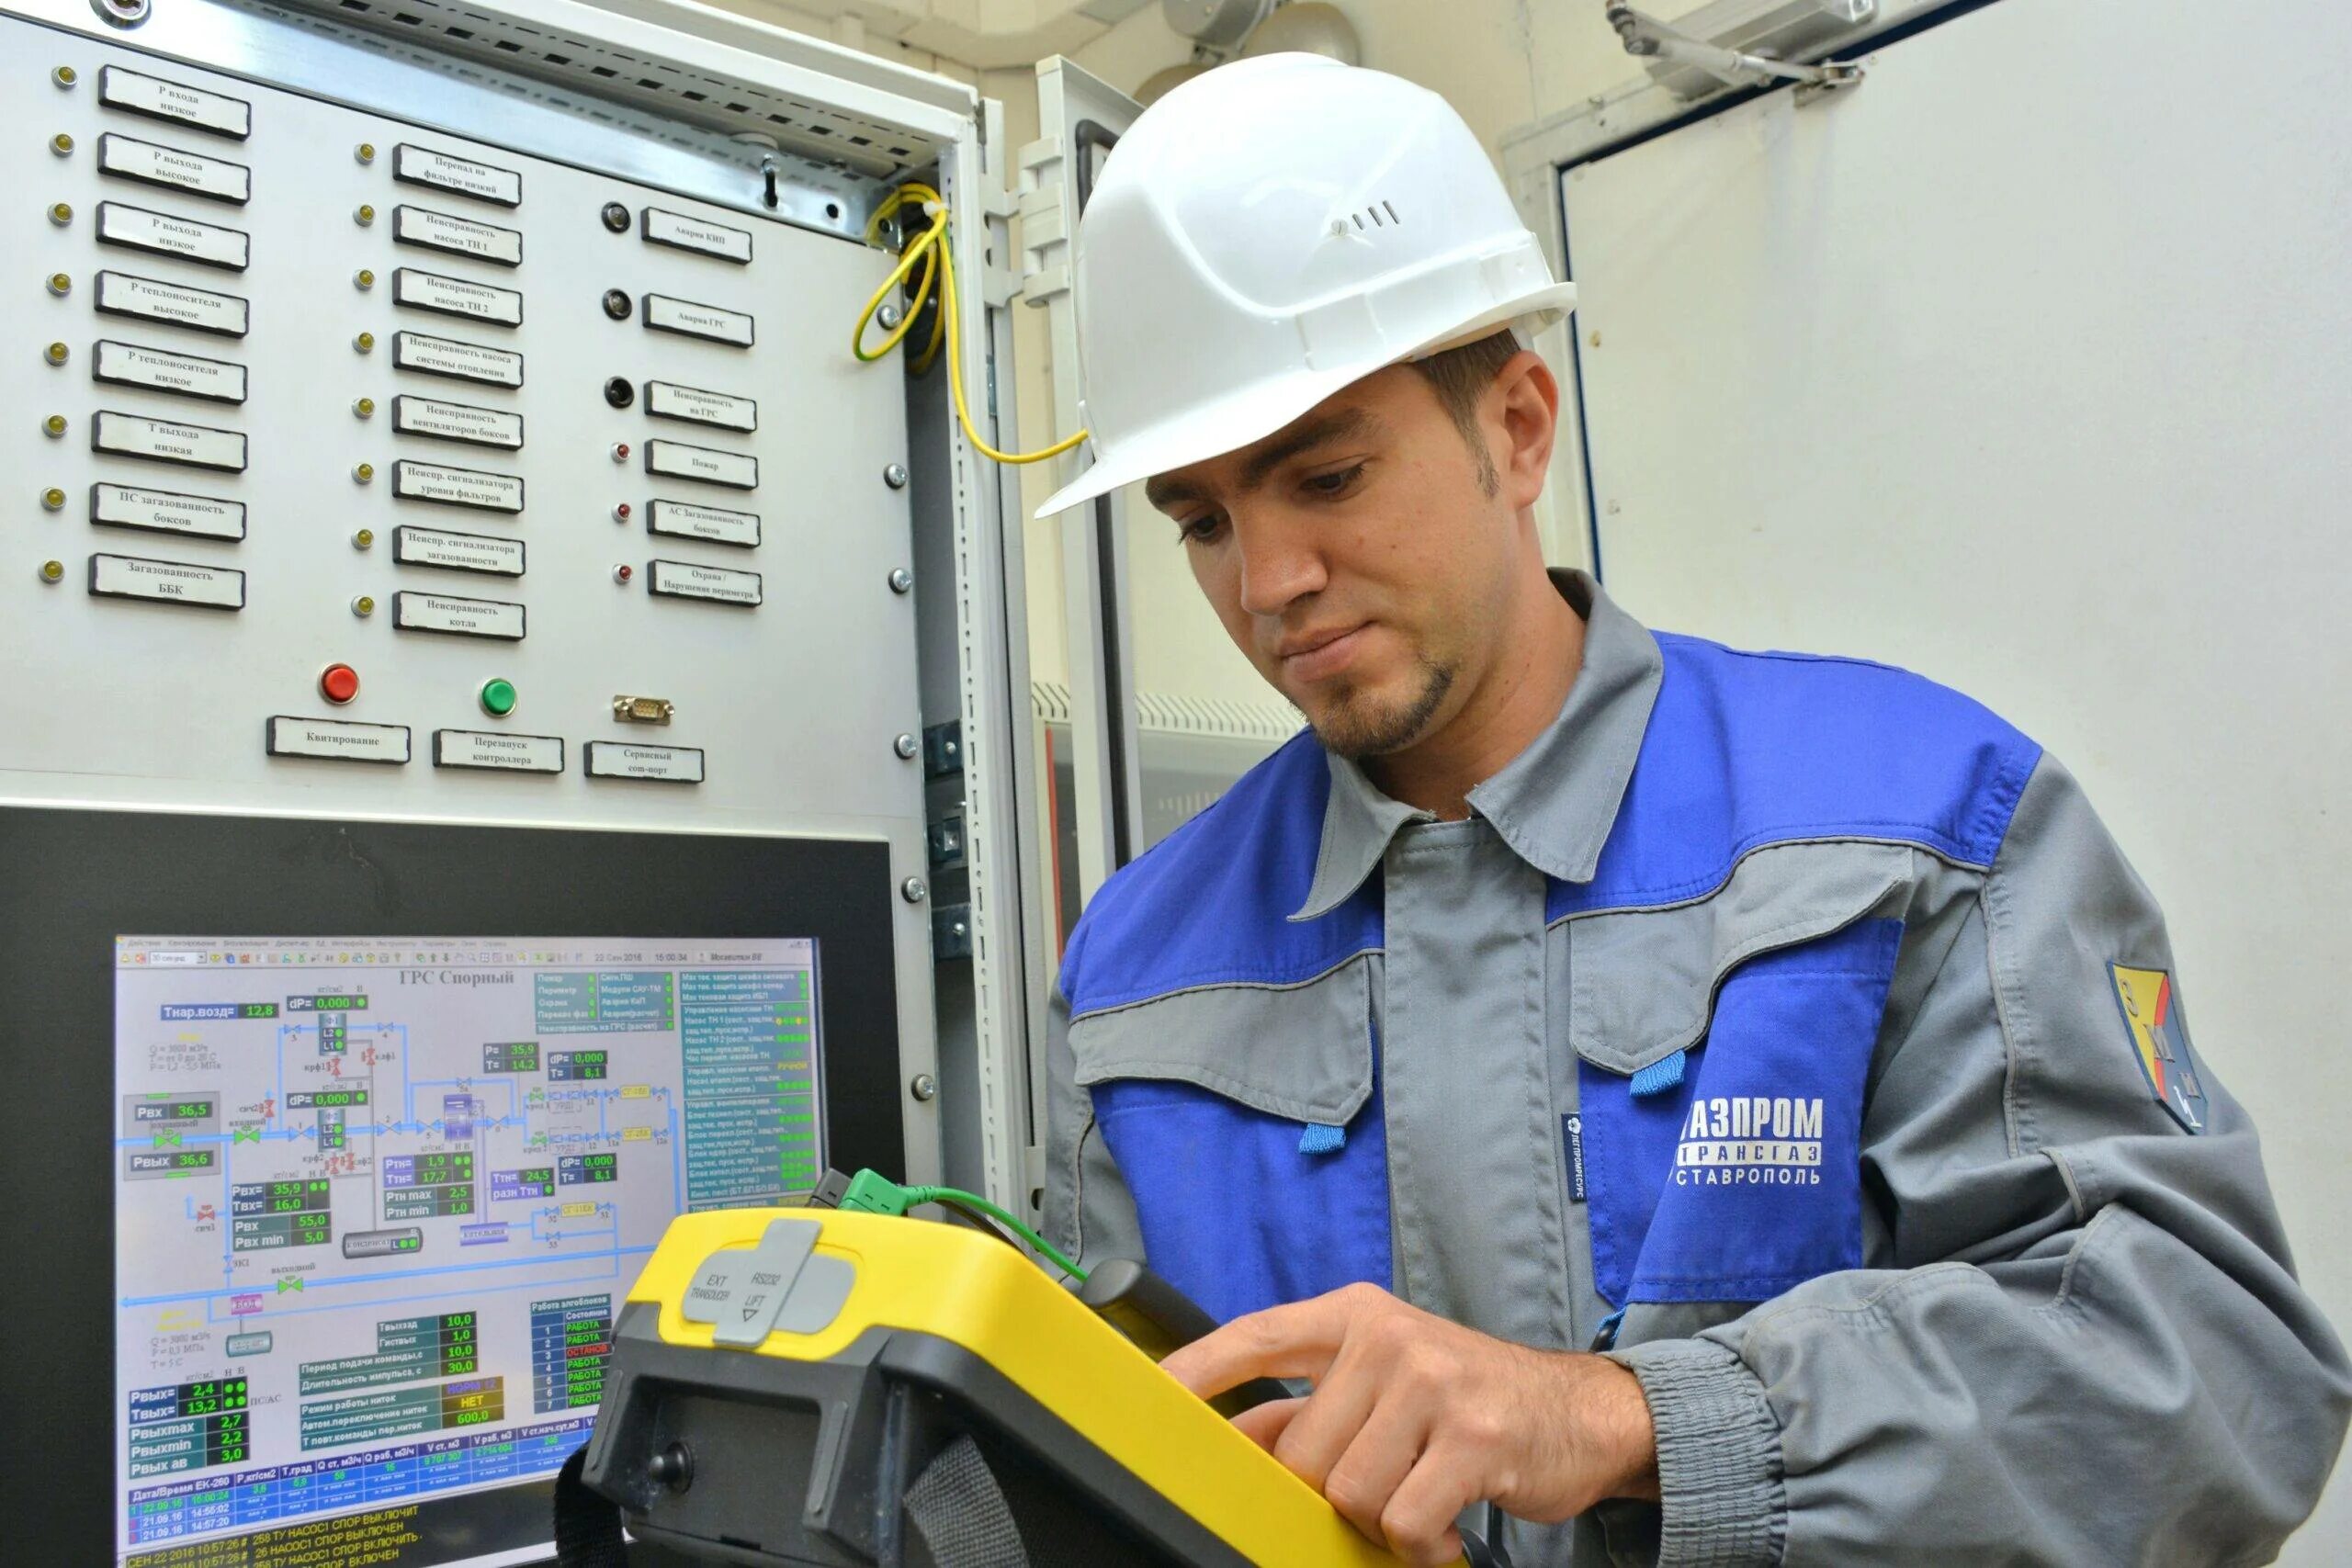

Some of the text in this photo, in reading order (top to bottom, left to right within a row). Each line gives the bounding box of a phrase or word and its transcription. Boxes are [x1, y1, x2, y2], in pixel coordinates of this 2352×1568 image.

[168, 88, 198, 104] входа
[161, 102, 197, 118] низкое
[163, 155, 203, 172] выхода
[155, 166, 200, 185] высокое
[475, 168, 485, 176] на
[424, 170, 497, 194] фильтре низкий
[162, 221, 202, 238] выхода
[426, 215, 495, 238] Неисправность
[159, 237, 196, 252] низкое
[435, 232, 464, 246] насоса
[466, 239, 481, 250] ТН
[706, 233, 725, 244] КИП
[427, 278, 496, 299] Неисправность
[141, 286, 221, 309] теплоносителя
[435, 296, 464, 308] насоса
[466, 301, 481, 311] ТН
[153, 304, 199, 320] высокое
[709, 319, 726, 329] ГРС
[409, 336, 511, 364] Неисправность насоса
[139, 354, 219, 376] теплоносителя
[416, 355, 504, 378] системы отопления
[154, 373, 192, 387] низкое
[674, 389, 733, 409] Неисправность
[426, 404, 496, 424] Неисправность
[701, 408, 718, 418] ГРС
[159, 426, 199, 441] выхода
[413, 418, 510, 440] вентиляторов боксов
[154, 443, 193, 456] низкая
[692, 458, 718, 470] Пожар
[408, 467, 514, 490] Неиспр. сигнализатора
[421, 486, 501, 503] уровня фильтров
[119, 491, 225, 514] ПС загазованность
[153, 513, 191, 526] боксов
[683, 509, 744, 525] Загазованность
[694, 525, 720, 535] боксов
[409, 533, 514, 554] Неиспр. сигнализатора
[427, 553, 498, 567] загазованности
[128, 561, 213, 581] Загазованность
[158, 583, 184, 595] ББК
[664, 580, 753, 599] Нарушение периметра
[427, 600, 498, 615] Неисправность
[449, 618, 476, 628] котла
[307, 731, 379, 747] Квитирование
[475, 737, 527, 751] Перезапуск
[472, 751, 532, 765] контроллера
[624, 748, 672, 761] Сервисный
[400, 970, 514, 985] ГРС Спорный
[317, 998, 350, 1009] 0,000
[246, 1006, 273, 1017] 12,8
[511, 1044, 535, 1056] 35,9
[512, 1059, 535, 1071] 14,2
[574, 1053, 604, 1065] 0,000
[584, 1067, 600, 1079] 8,1
[316, 1094, 349, 1106] 0,000
[178, 1104, 207, 1117] 36,5
[1679, 1098, 1823, 1141] АЗПРОМ
[179, 1154, 208, 1167] 36,6
[1681, 1145, 1817, 1162] ТРАНСГАЗ
[428, 1156, 445, 1168] 1,9
[584, 1156, 613, 1167] 0,000
[1571, 1134, 1584, 1198] ЛЕГПРОМРЕСУРС
[423, 1172, 447, 1183] 17,7
[526, 1170, 549, 1181] 24,5
[595, 1170, 610, 1181] 8,1
[1676, 1168, 1820, 1185] СТАВРОПОЛЬ
[274, 1182, 300, 1195] 35,9
[409, 1188, 467, 1200] max 2,5
[275, 1199, 300, 1211] 16,0
[409, 1203, 467, 1214] min 1,0
[299, 1214, 325, 1227] 55,0
[262, 1235, 283, 1246] min
[305, 1232, 323, 1243] 5,0
[707, 1274, 729, 1286] EXT
[751, 1272, 781, 1286] RS232
[745, 1294, 766, 1306] LIFT
[447, 1314, 472, 1327] 10,0
[566, 1322, 599, 1332] РАБОТА
[453, 1330, 470, 1343] 1,0
[567, 1334, 599, 1344] РАБОТА
[301, 1345, 472, 1374] Период подачи 10,0
[568, 1359, 601, 1369] РАБОТА
[301, 1360, 473, 1392] Длительность 30,0
[569, 1371, 601, 1381] РАБОТА
[193, 1383, 214, 1397] 2,4
[569, 1382, 602, 1393] РАБОТА
[188, 1400, 216, 1414] 13,2
[301, 1394, 396, 1416] Режим работы ниток
[402, 1405, 428, 1416] ниток
[461, 1395, 483, 1407] НЕТ
[221, 1415, 242, 1428] 2,7
[221, 1432, 242, 1445] 2,2
[172, 1459, 187, 1469] ав
[221, 1449, 242, 1461] 3,0
[333, 1517, 360, 1530] СПОР
[316, 1533, 344, 1546] СПОР
[346, 1522, 403, 1540] ВЫКЛЮЧЕН
[333, 1542, 361, 1555] СПОР
[129, 1555, 152, 1567] СЕН
